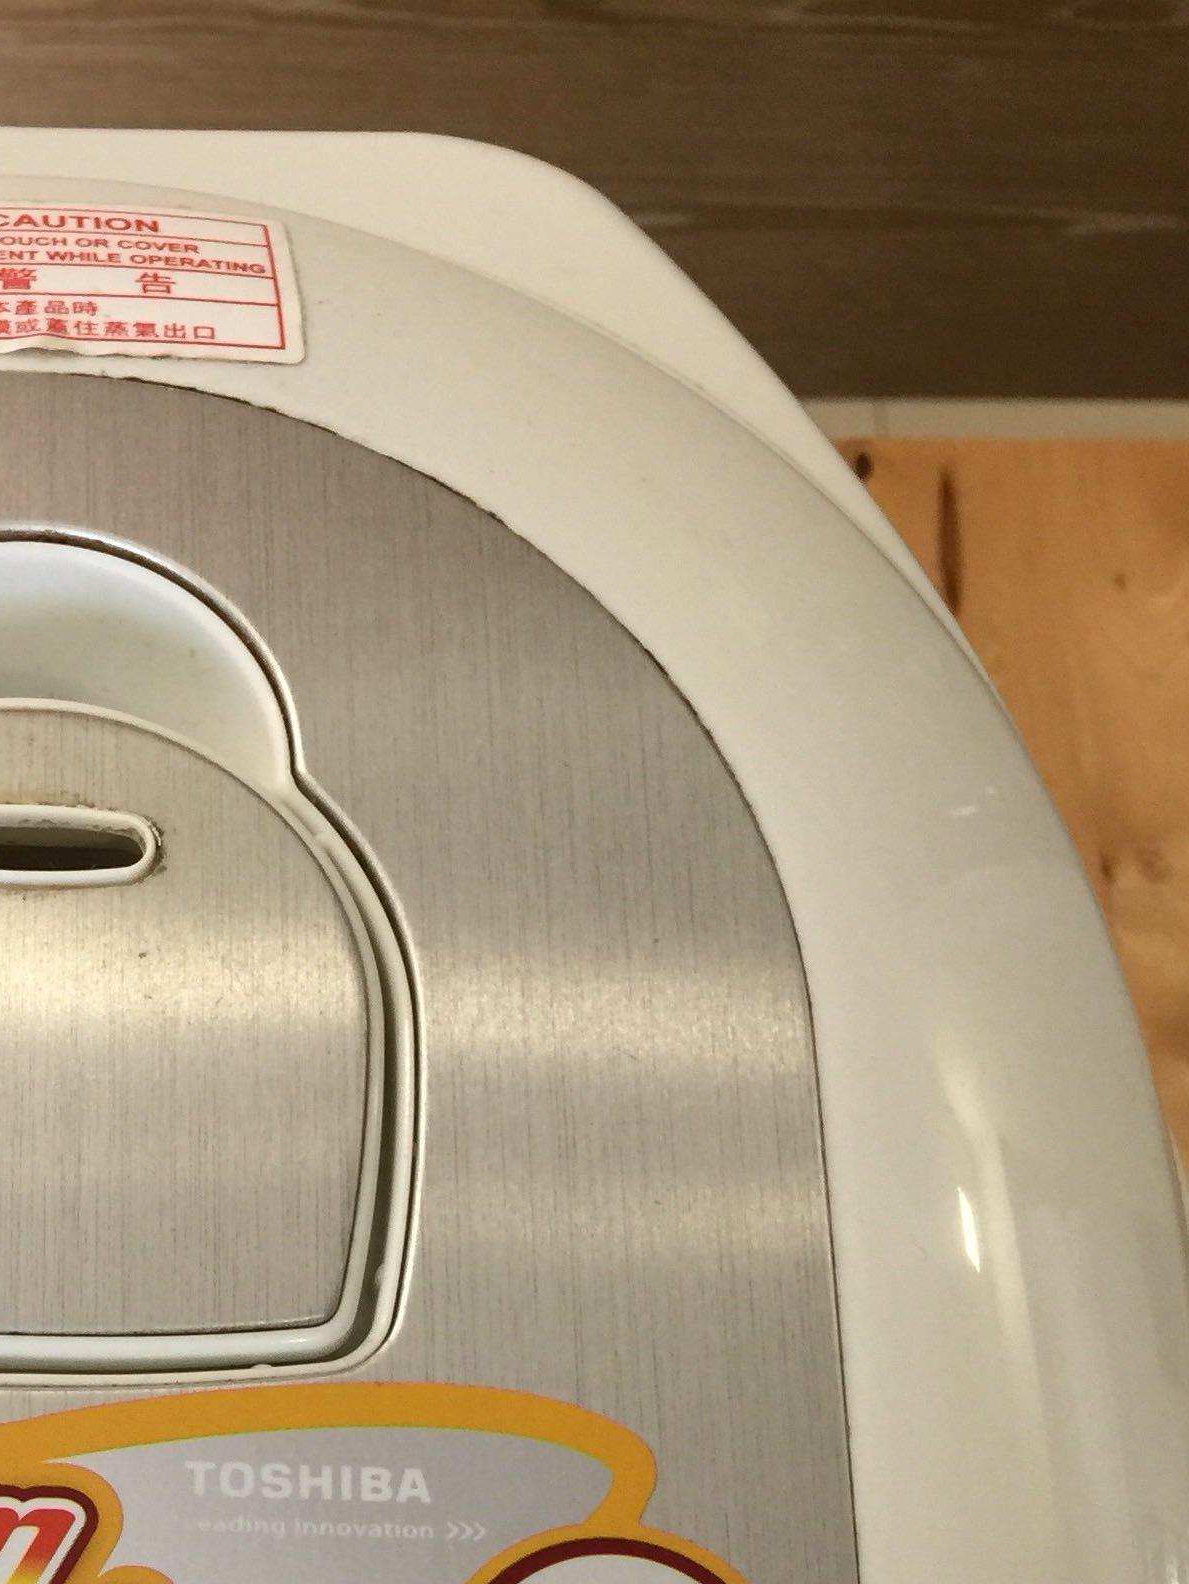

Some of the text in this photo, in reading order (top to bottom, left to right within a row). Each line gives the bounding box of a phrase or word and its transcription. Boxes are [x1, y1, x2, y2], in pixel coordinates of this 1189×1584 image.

[75, 237, 109, 250] OR
[117, 239, 200, 254] COVER
[48, 250, 122, 264] WHILE
[129, 252, 266, 274] OPERATING
[184, 1460, 433, 1504] TOSHIBA
[184, 1514, 434, 1540] eading innovation
